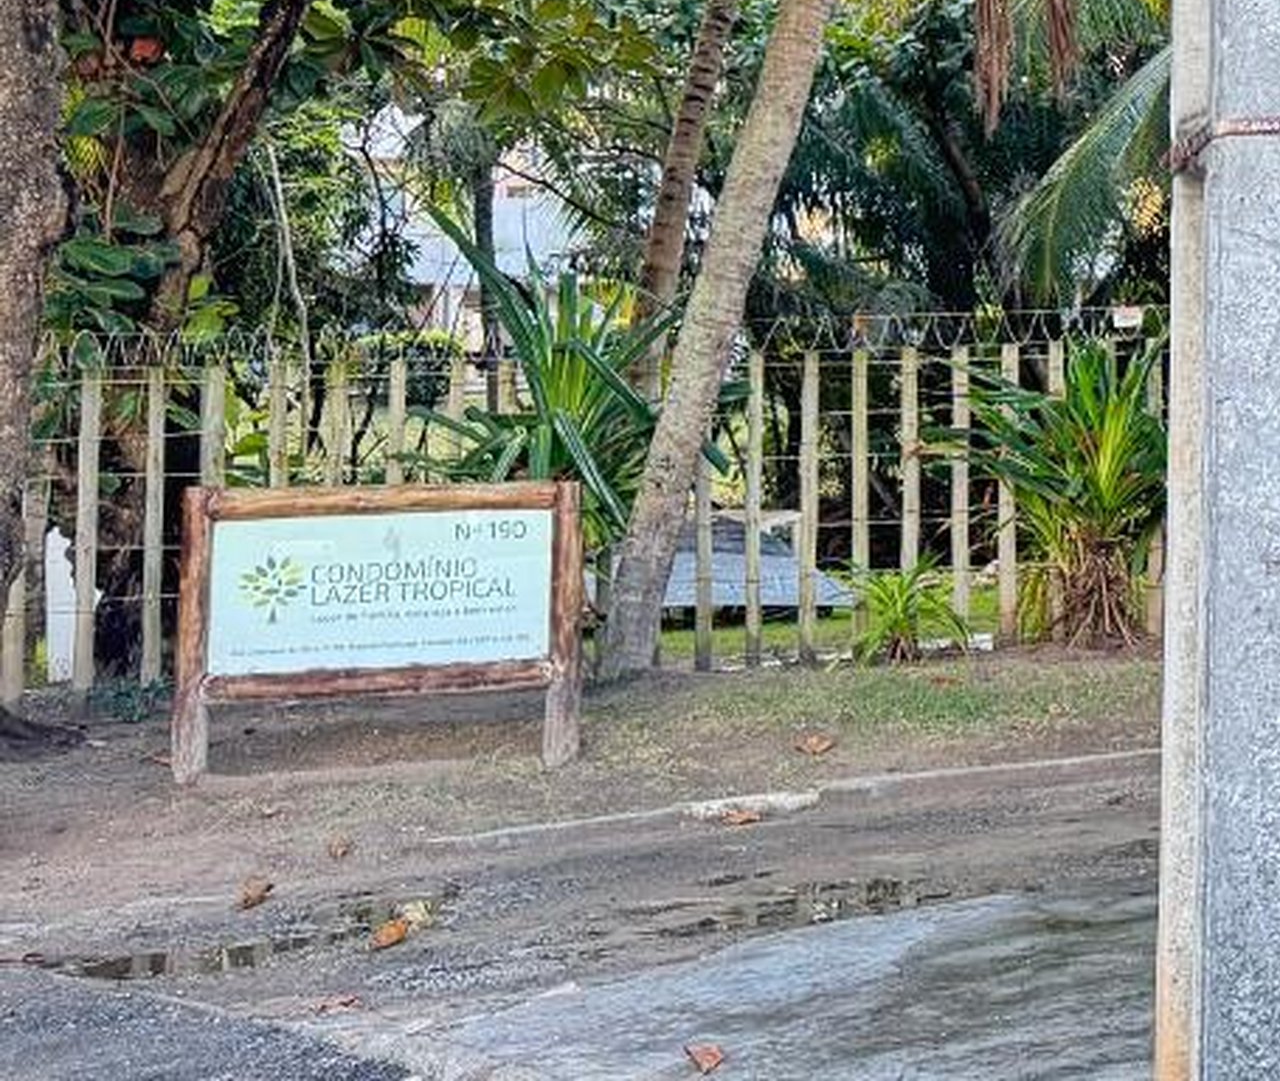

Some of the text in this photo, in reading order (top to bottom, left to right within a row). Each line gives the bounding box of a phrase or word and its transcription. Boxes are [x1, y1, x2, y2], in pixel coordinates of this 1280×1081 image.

[488, 519, 528, 539] 190
[310, 556, 478, 585] CONDOMÍNIO
[310, 578, 516, 607] LAZER TROPICAL
